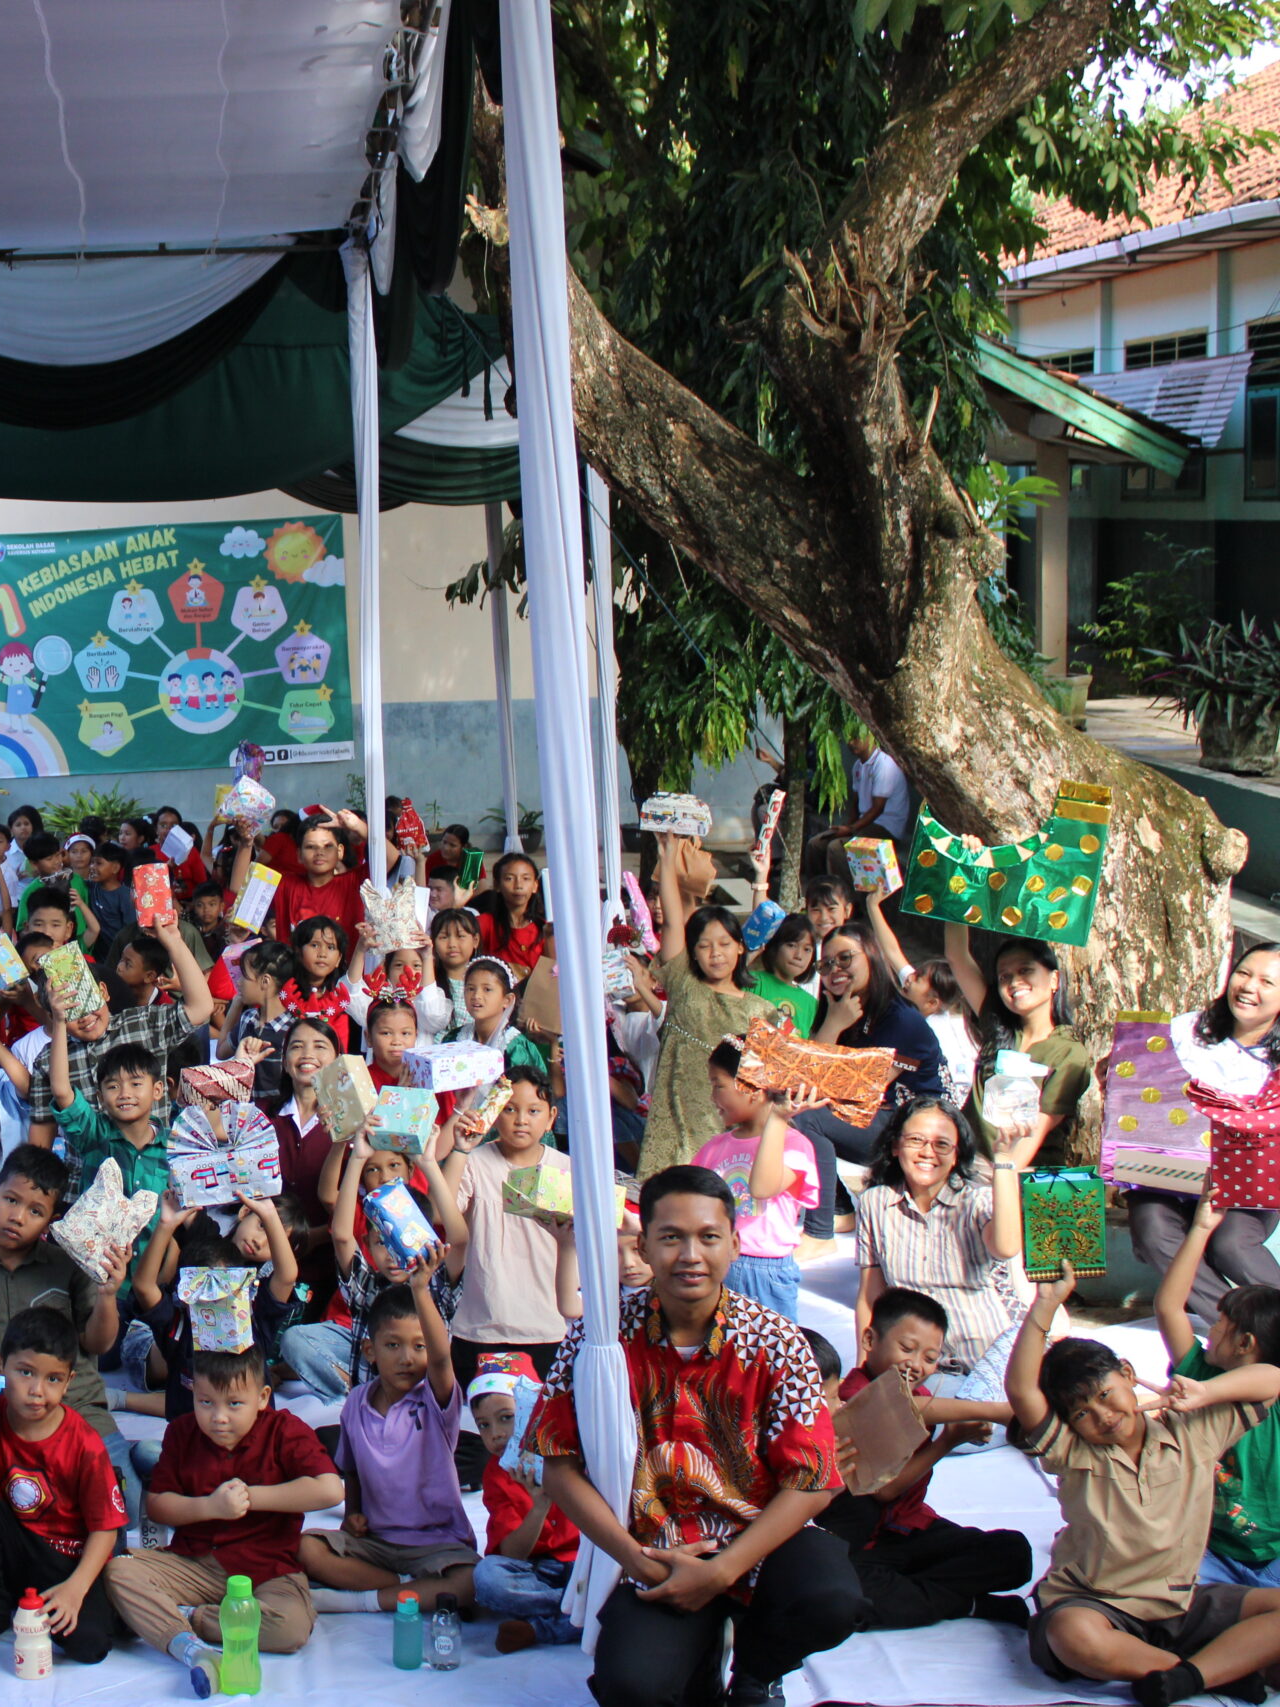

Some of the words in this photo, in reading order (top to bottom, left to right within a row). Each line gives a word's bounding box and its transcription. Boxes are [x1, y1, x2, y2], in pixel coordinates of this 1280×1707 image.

[17, 540, 119, 597] KEBIASAAN
[125, 527, 176, 554] ANAK
[28, 567, 116, 619] INDONESIA
[119, 549, 179, 580] HEBAT
[732, 1153, 751, 1163] AND
